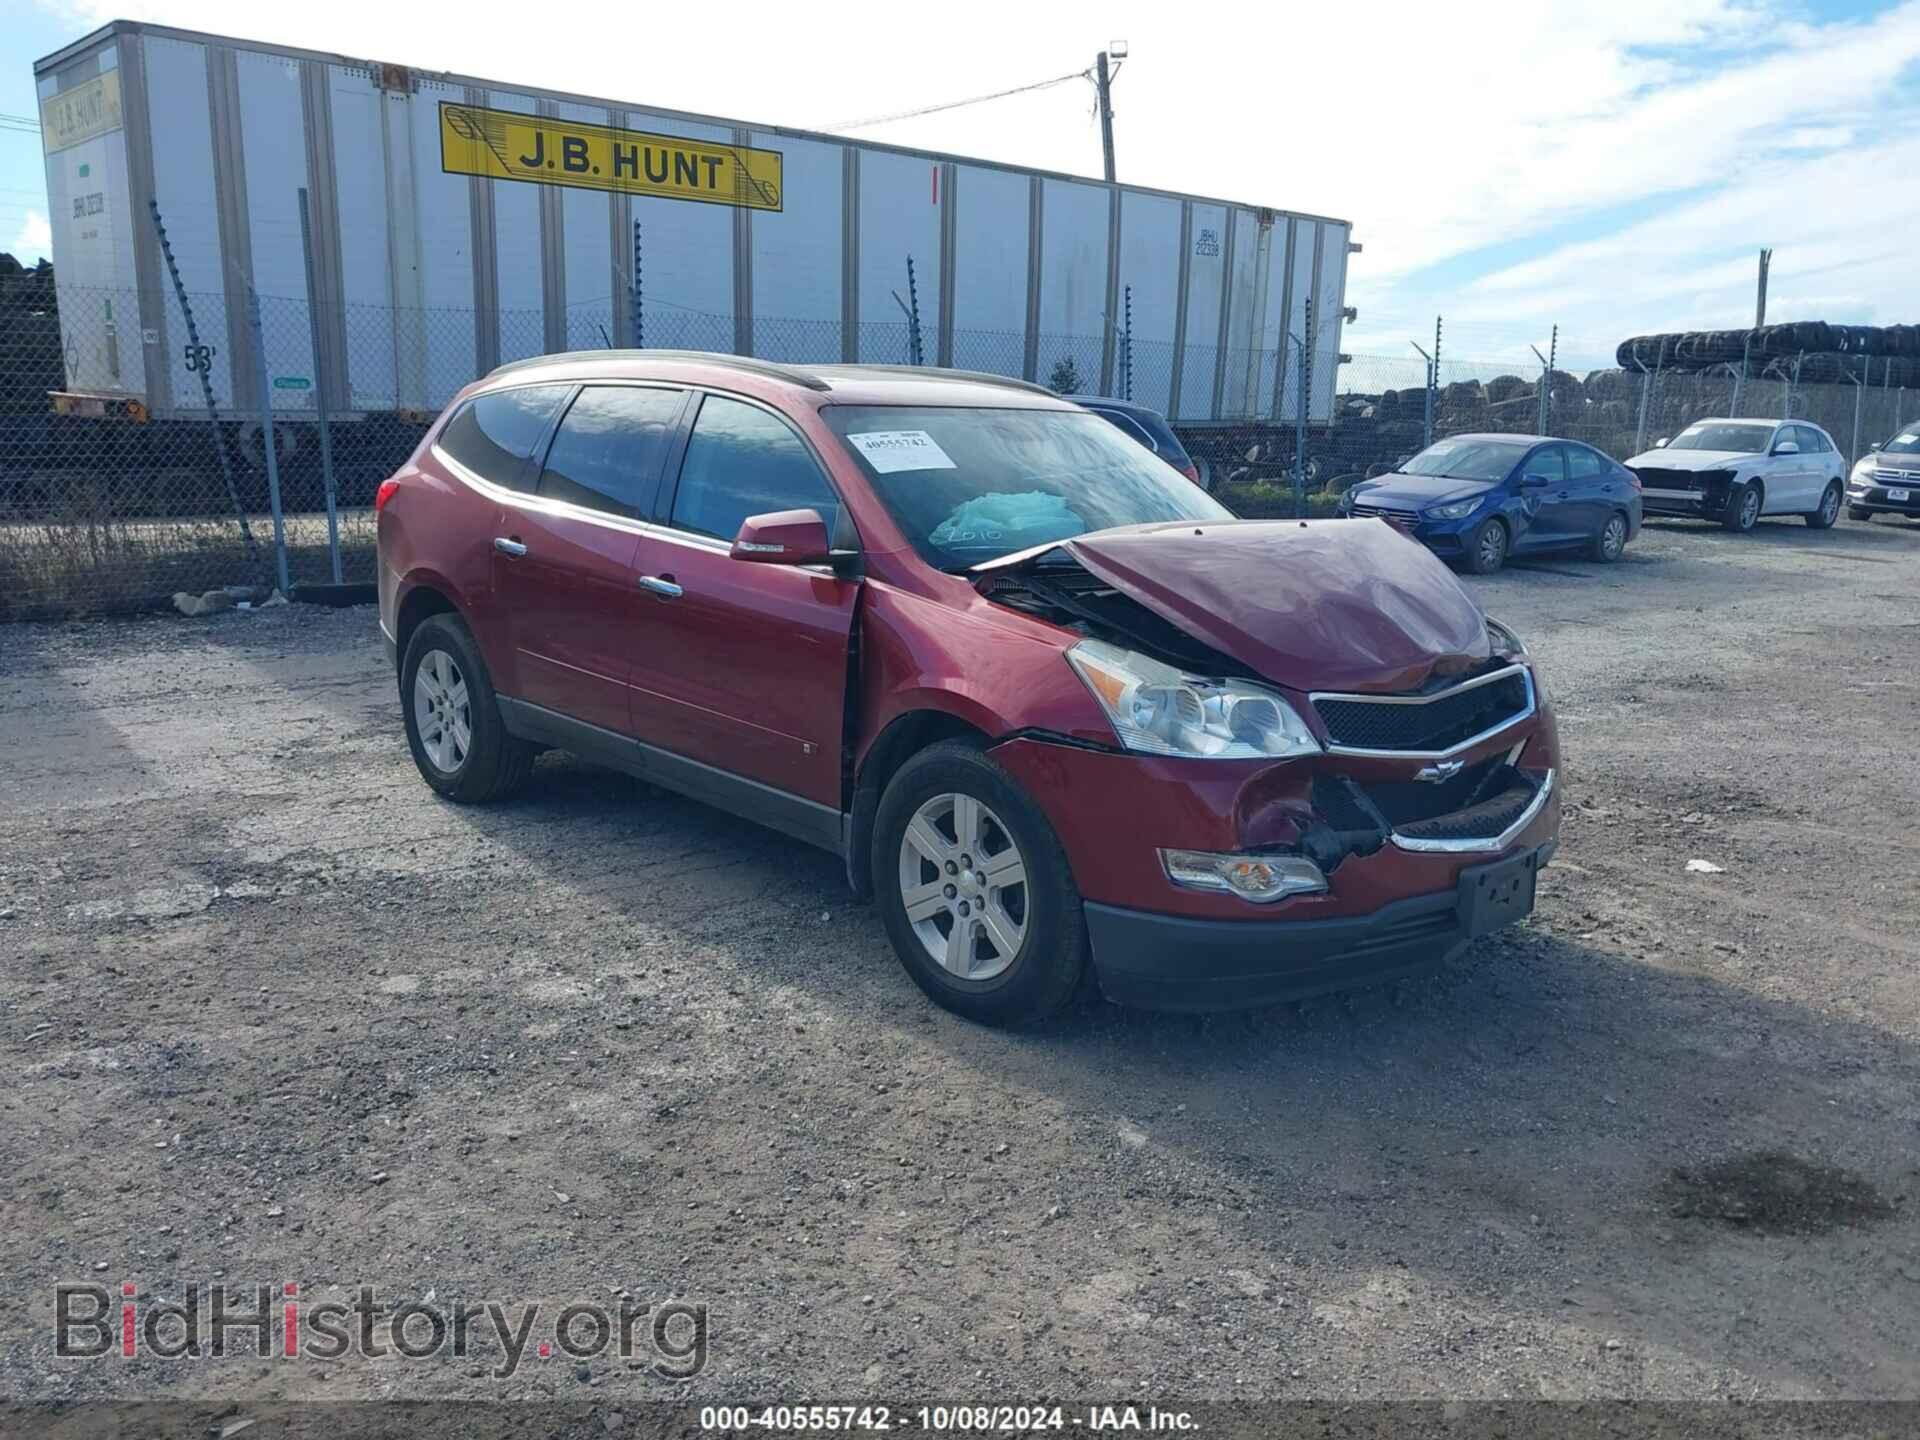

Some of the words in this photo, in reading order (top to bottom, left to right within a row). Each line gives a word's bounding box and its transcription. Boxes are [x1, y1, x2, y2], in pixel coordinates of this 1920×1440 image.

[519, 131, 600, 173] J.B.
[614, 142, 724, 189] HUNT
[944, 526, 1002, 542] 2010
